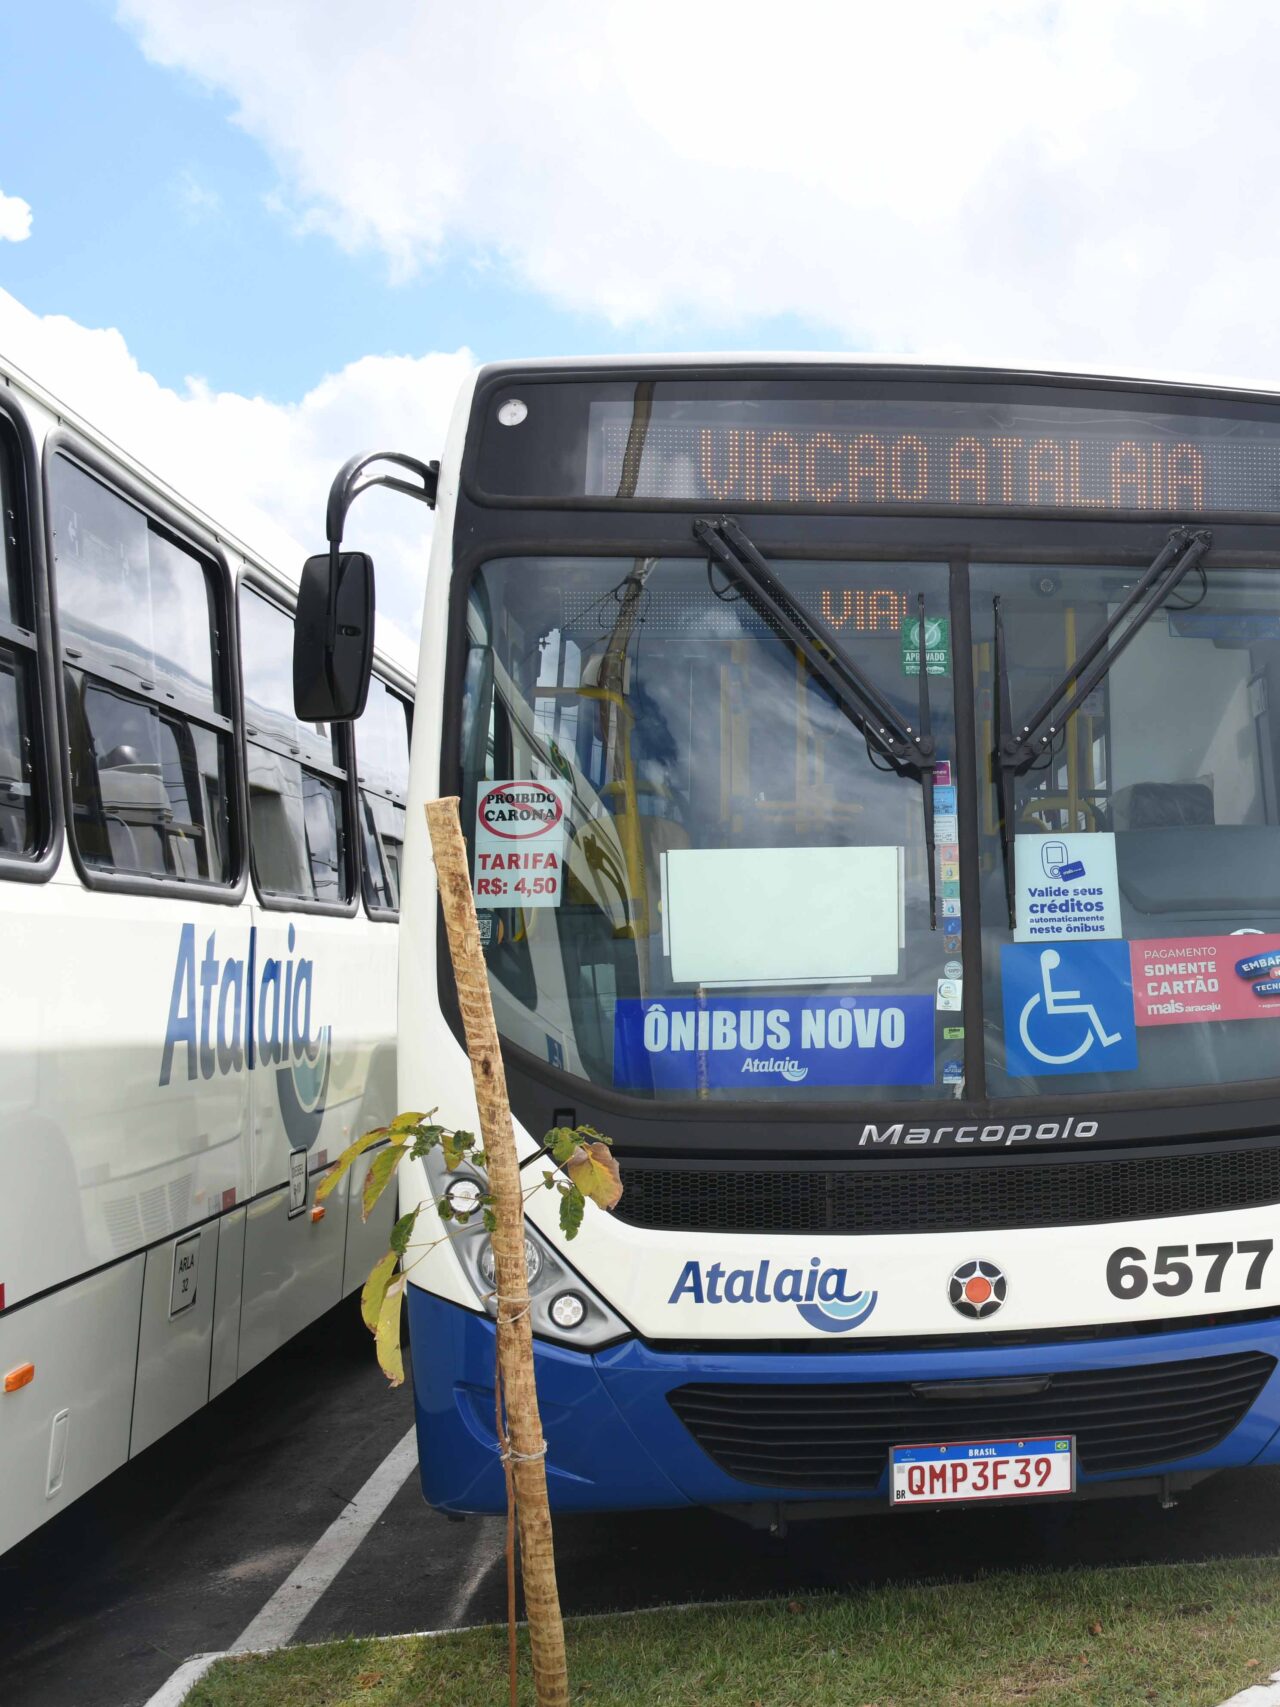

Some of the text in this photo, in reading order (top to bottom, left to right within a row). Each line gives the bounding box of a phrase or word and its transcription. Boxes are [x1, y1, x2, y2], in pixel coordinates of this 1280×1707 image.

[701, 429, 1203, 510] VIACAO ATALAIA
[905, 652, 946, 662] APRVADO
[486, 792, 557, 805] PROIBIDO
[484, 808, 558, 822] CARONA
[478, 852, 559, 871] TARIFA
[477, 876, 557, 898] R$: 4,50
[1028, 886, 1104, 898] Valide seus
[1028, 898, 1105, 914] créditos
[1029, 915, 1105, 924] automaticamente
[1029, 923, 1106, 935] neste ônibus
[1144, 946, 1217, 960] PAGAMENTO
[1144, 961, 1217, 977] SOMENTE
[1146, 975, 1220, 997] CARTÃO
[158, 922, 327, 1088] Atalaia
[1147, 999, 1222, 1016] mais aracaju
[643, 1003, 906, 1053] ÔNIBUS NOVO
[740, 1056, 805, 1073] Atalaia
[857, 1116, 1100, 1148] Marcopolo
[178, 1253, 195, 1274] ARLA
[1105, 1238, 1275, 1301] 6577
[181, 1278, 190, 1293] 32
[667, 1255, 866, 1305] Atalaia
[968, 1447, 997, 1457] BRASIL
[907, 1457, 1052, 1496] QMP3F39
[896, 1489, 906, 1500] BR
